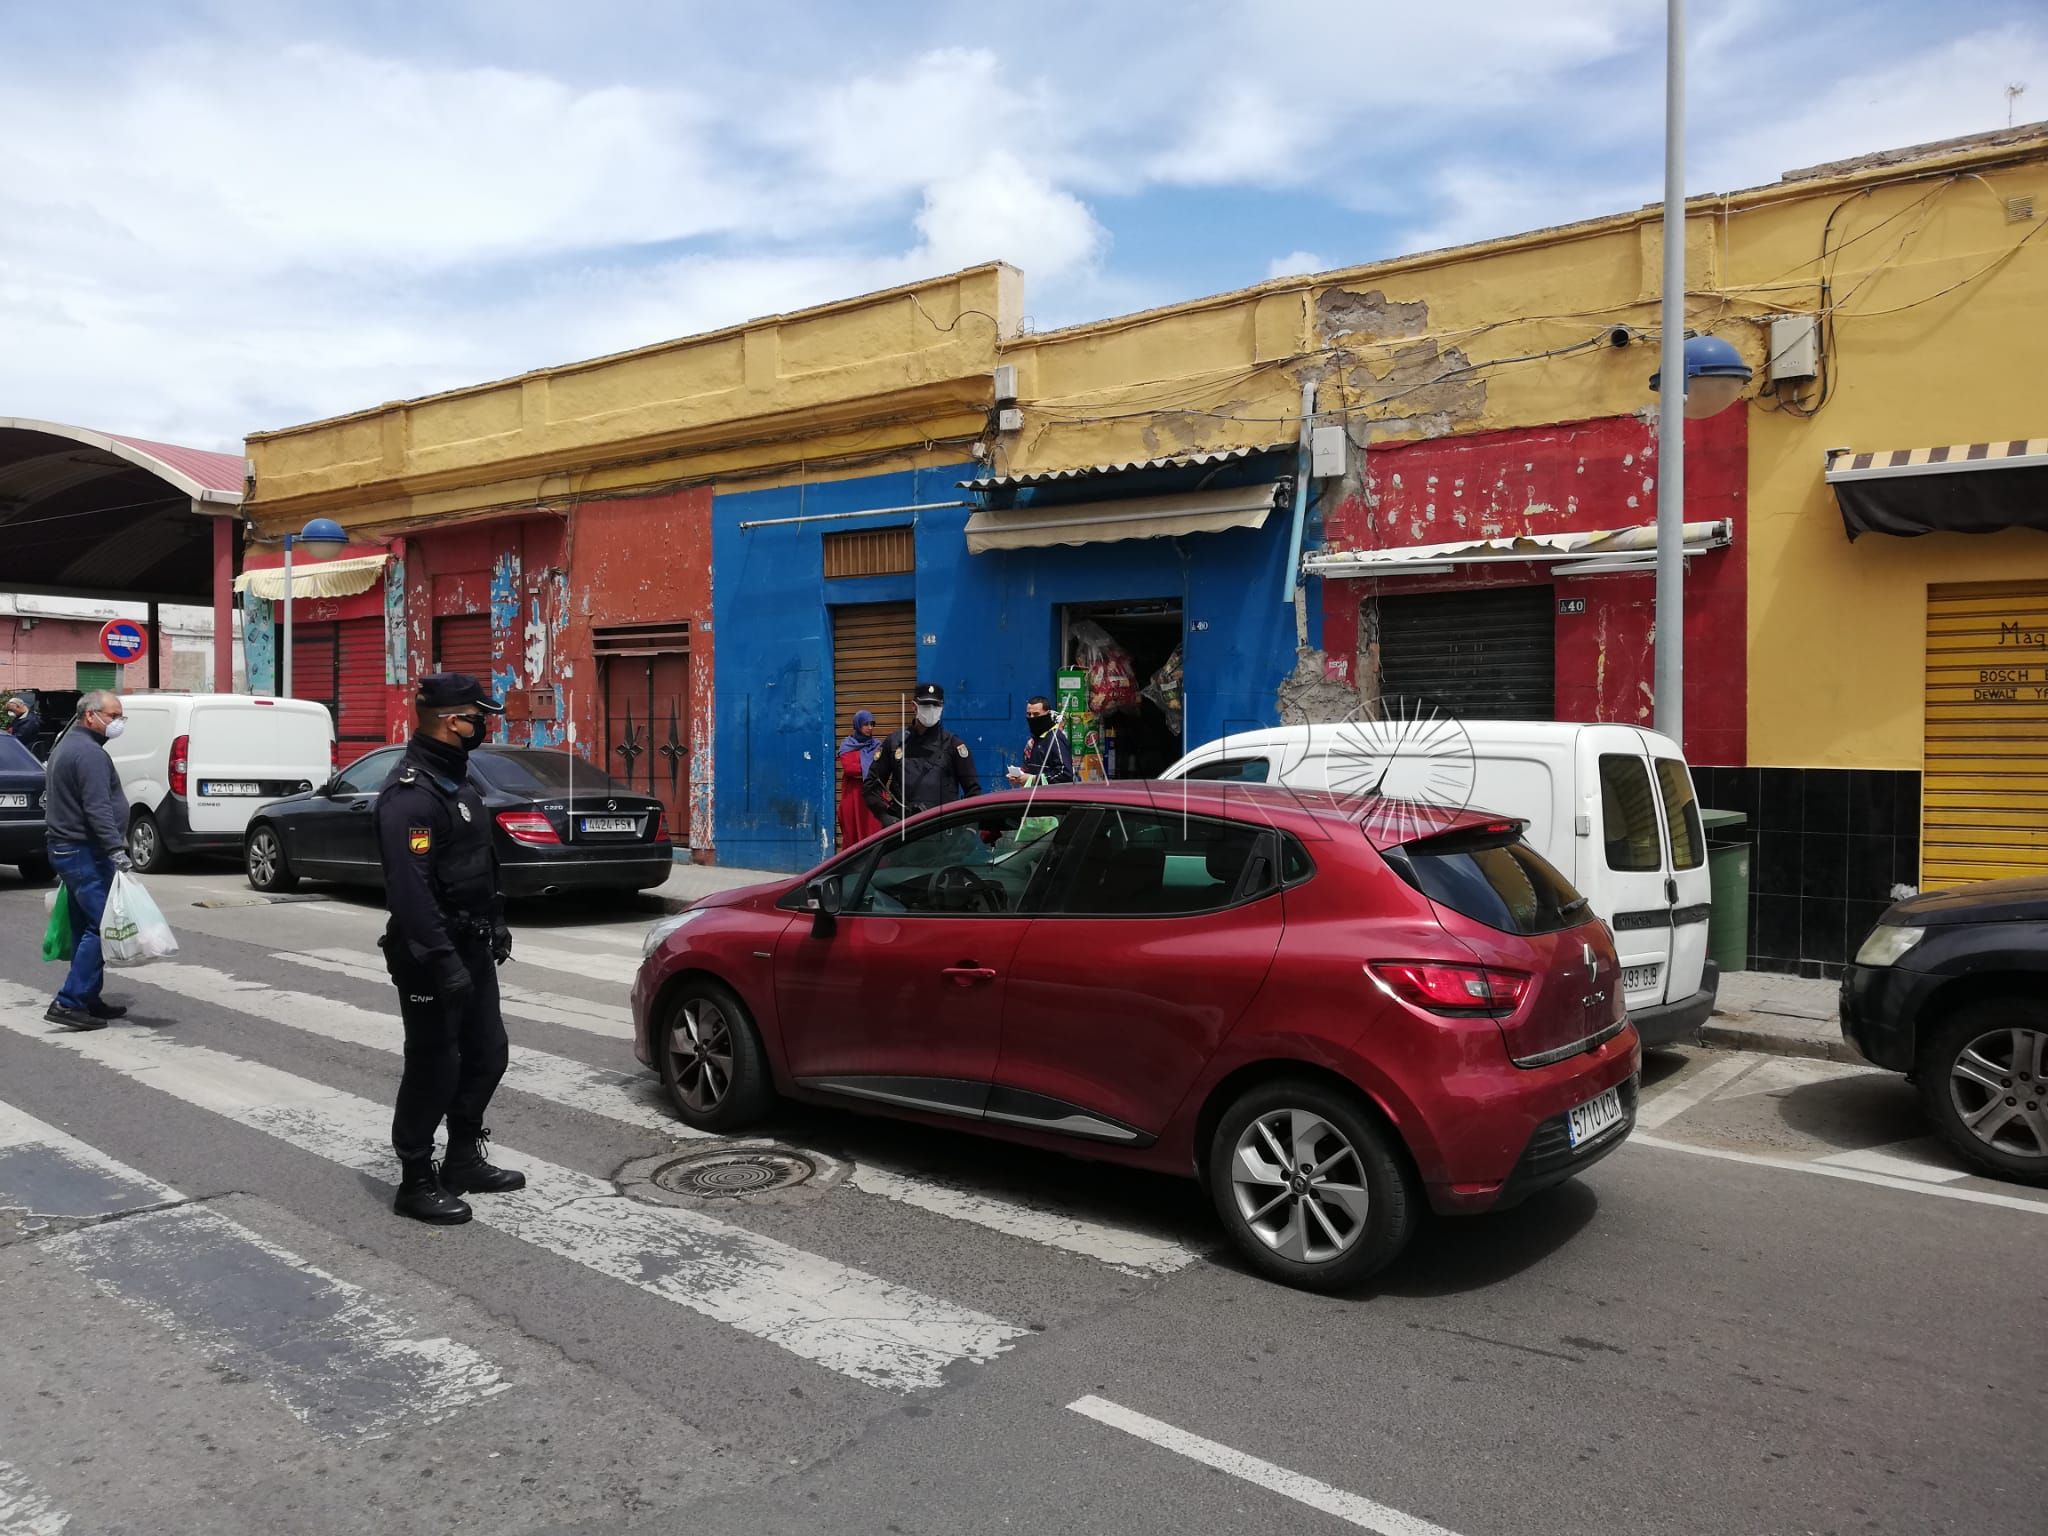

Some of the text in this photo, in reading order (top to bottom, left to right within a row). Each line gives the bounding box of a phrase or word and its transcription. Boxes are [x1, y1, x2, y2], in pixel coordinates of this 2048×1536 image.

[1567, 601, 1584, 612] 40
[1979, 670, 2029, 683] BOSCH
[12, 795, 26, 806] VB
[589, 819, 613, 830] 4424
[1642, 967, 1658, 986] GJB
[409, 994, 434, 1003] CNP
[1571, 1088, 1621, 1138] 5710 KDK
